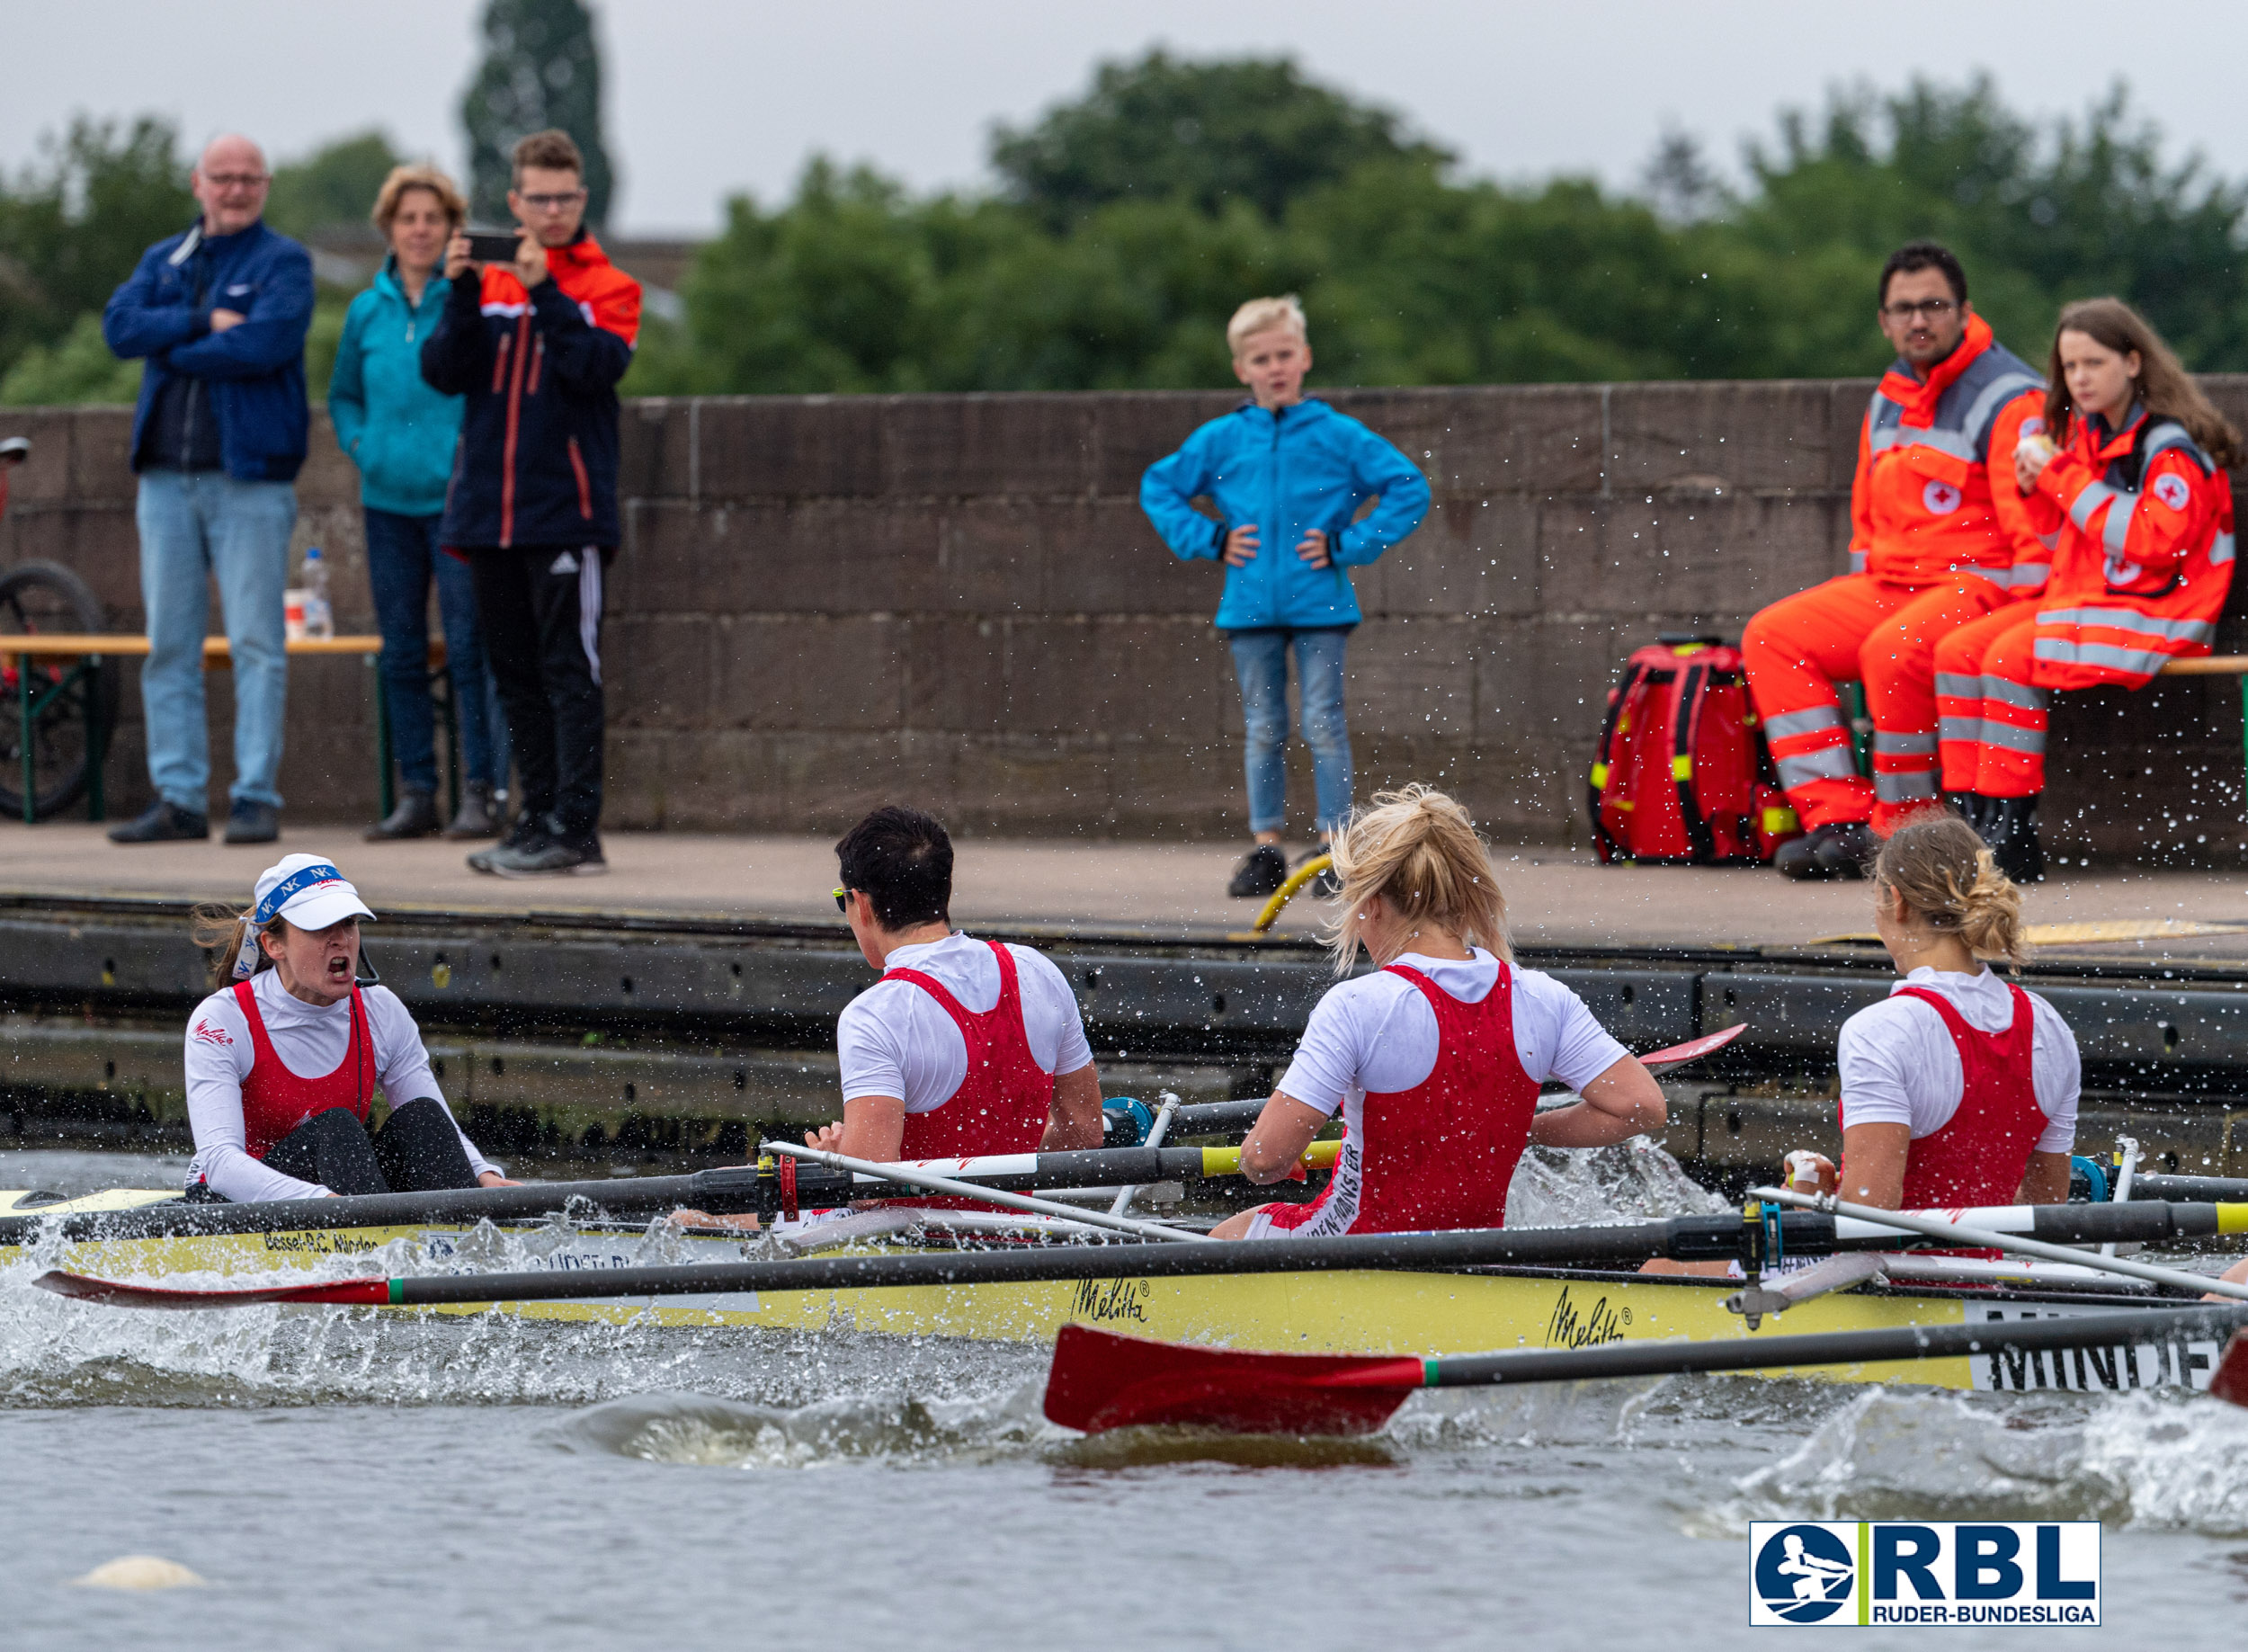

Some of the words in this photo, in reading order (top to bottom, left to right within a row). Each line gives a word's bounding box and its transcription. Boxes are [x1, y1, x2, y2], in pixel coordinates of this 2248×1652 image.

[261, 897, 275, 918] NK
[280, 877, 301, 897] NK
[309, 867, 332, 880] NK
[1069, 1277, 1148, 1323] Melitta
